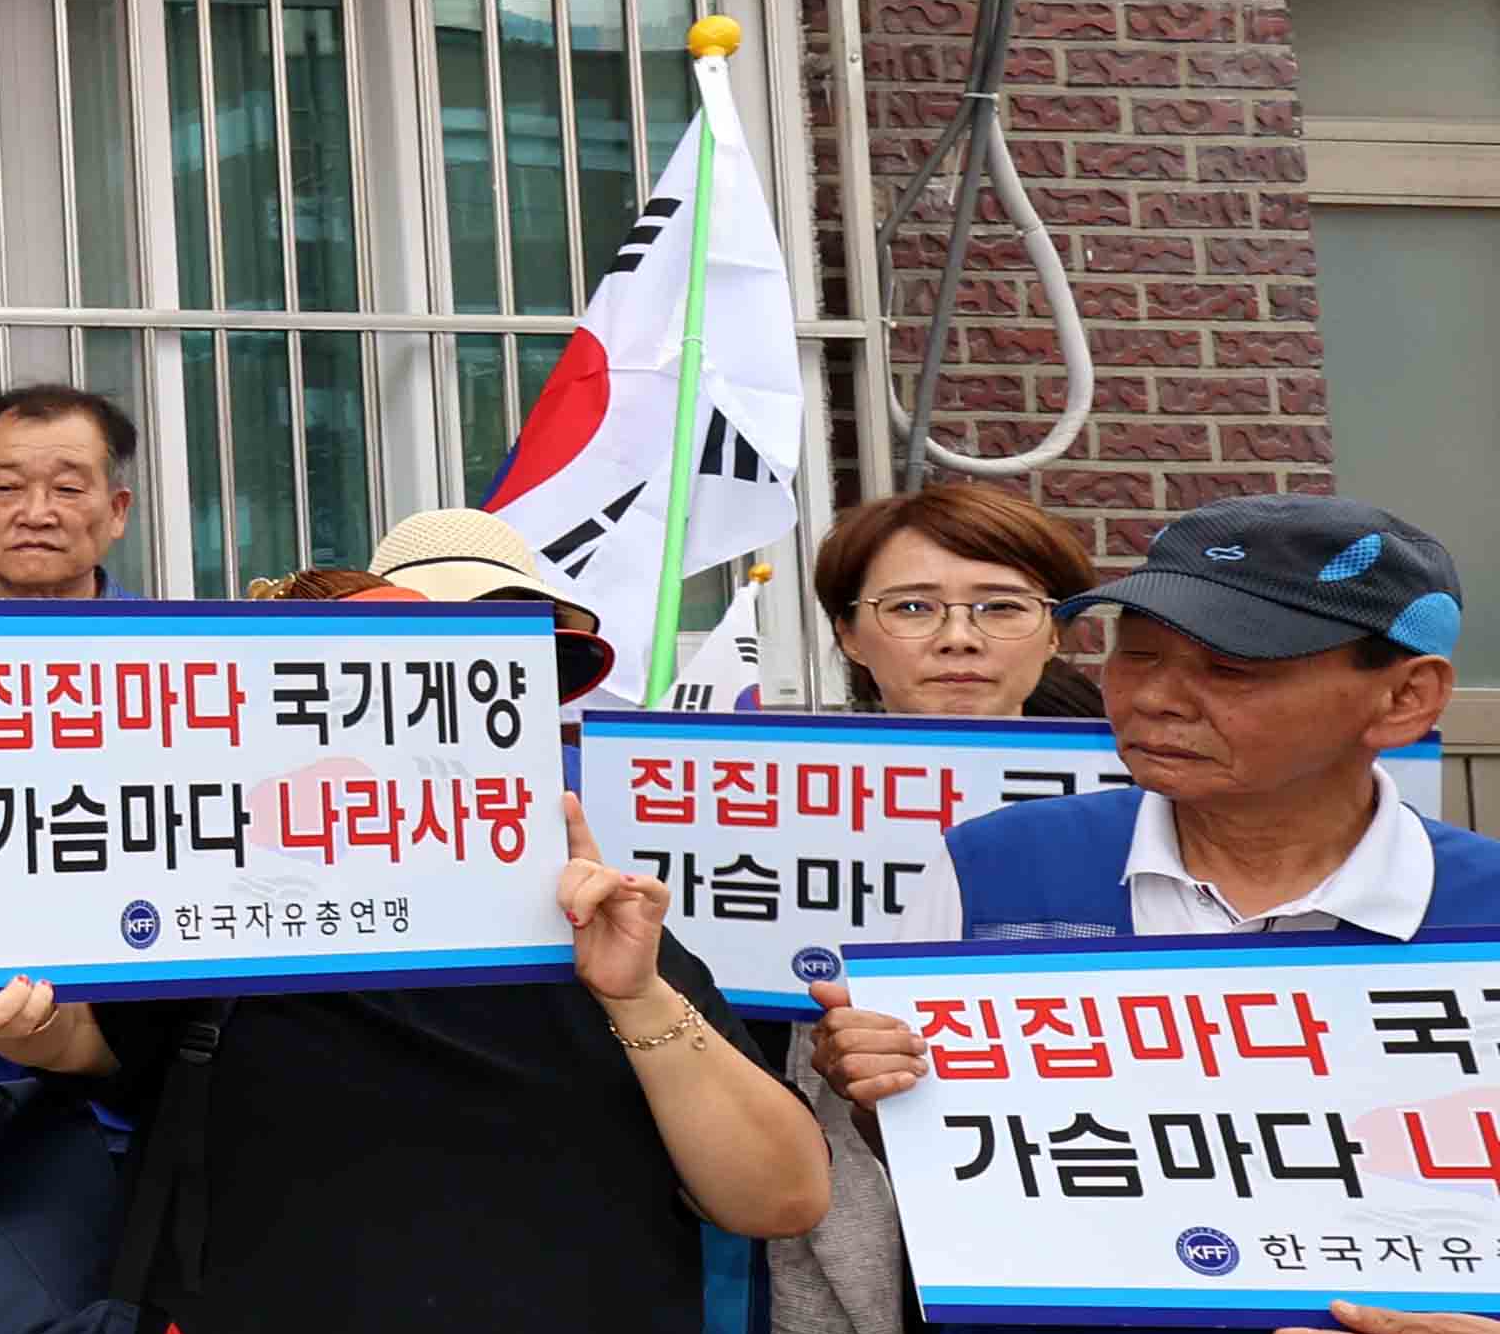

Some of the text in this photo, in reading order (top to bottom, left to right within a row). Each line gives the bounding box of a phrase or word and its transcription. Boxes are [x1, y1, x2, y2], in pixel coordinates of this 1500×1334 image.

[272, 659, 527, 748] 국기게양
[277, 776, 534, 864] 나라사랑
[630, 758, 963, 834] 집집마다
[174, 899, 409, 940] 한국자유총연맹
[914, 988, 1500, 1079] 집집마다 국
[943, 1112, 1364, 1199] 가슴마다
[1259, 1232, 1500, 1274] 한국자유
